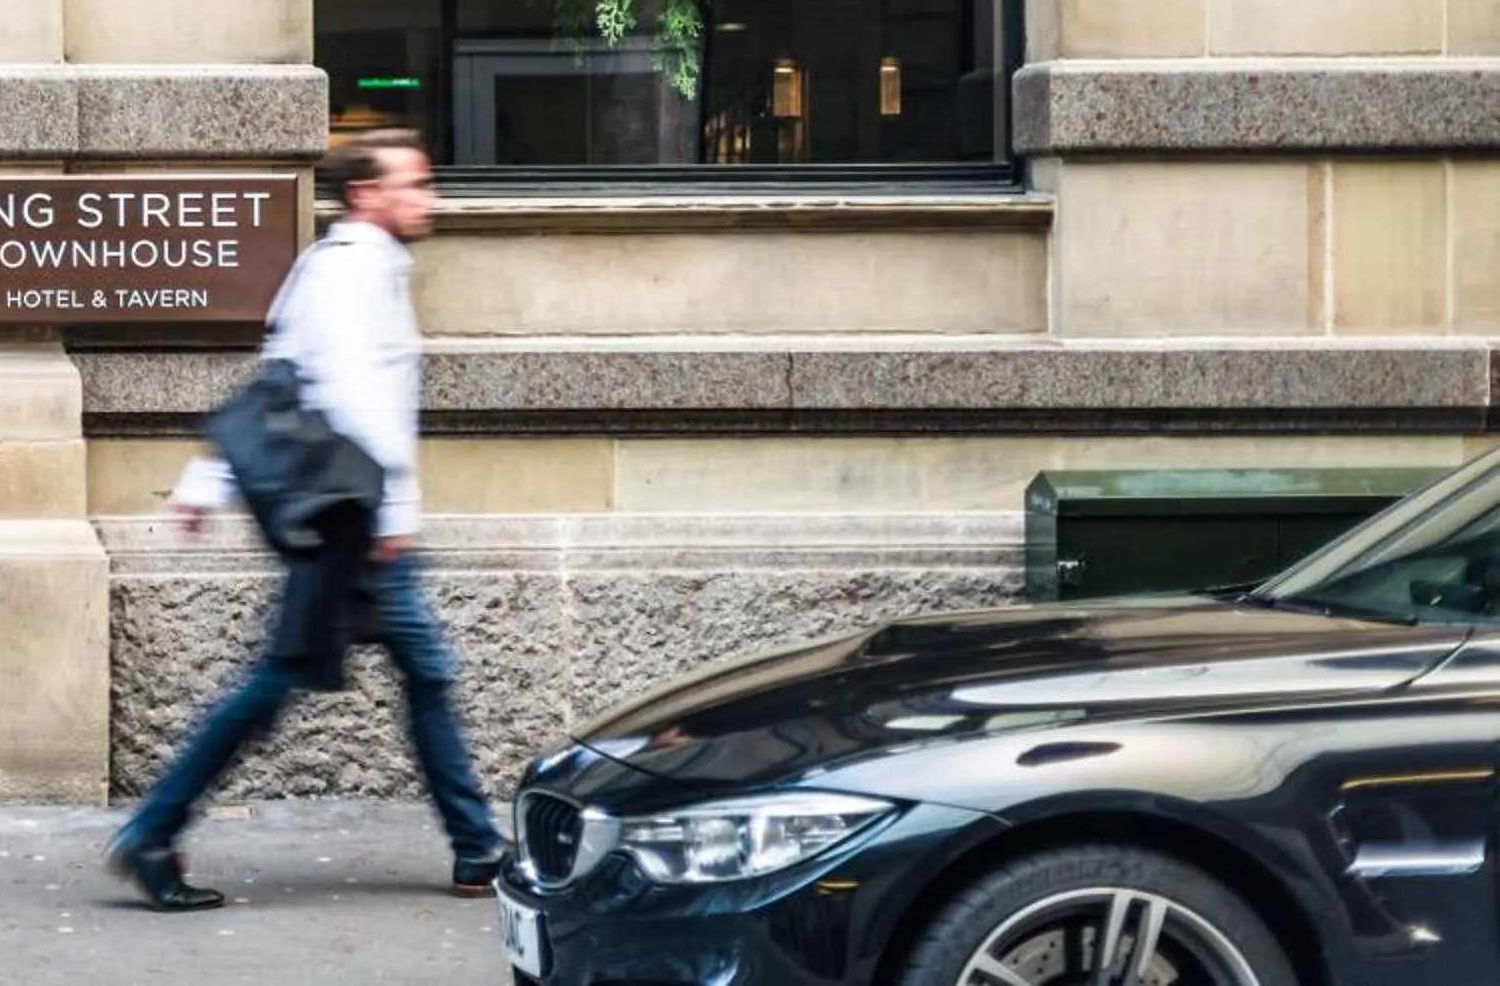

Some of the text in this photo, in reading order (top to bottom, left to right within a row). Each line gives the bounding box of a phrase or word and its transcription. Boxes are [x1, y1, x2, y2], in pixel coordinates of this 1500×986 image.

[78, 193, 270, 227] STREET
[7, 289, 207, 308] HOTEL & TAVERN
